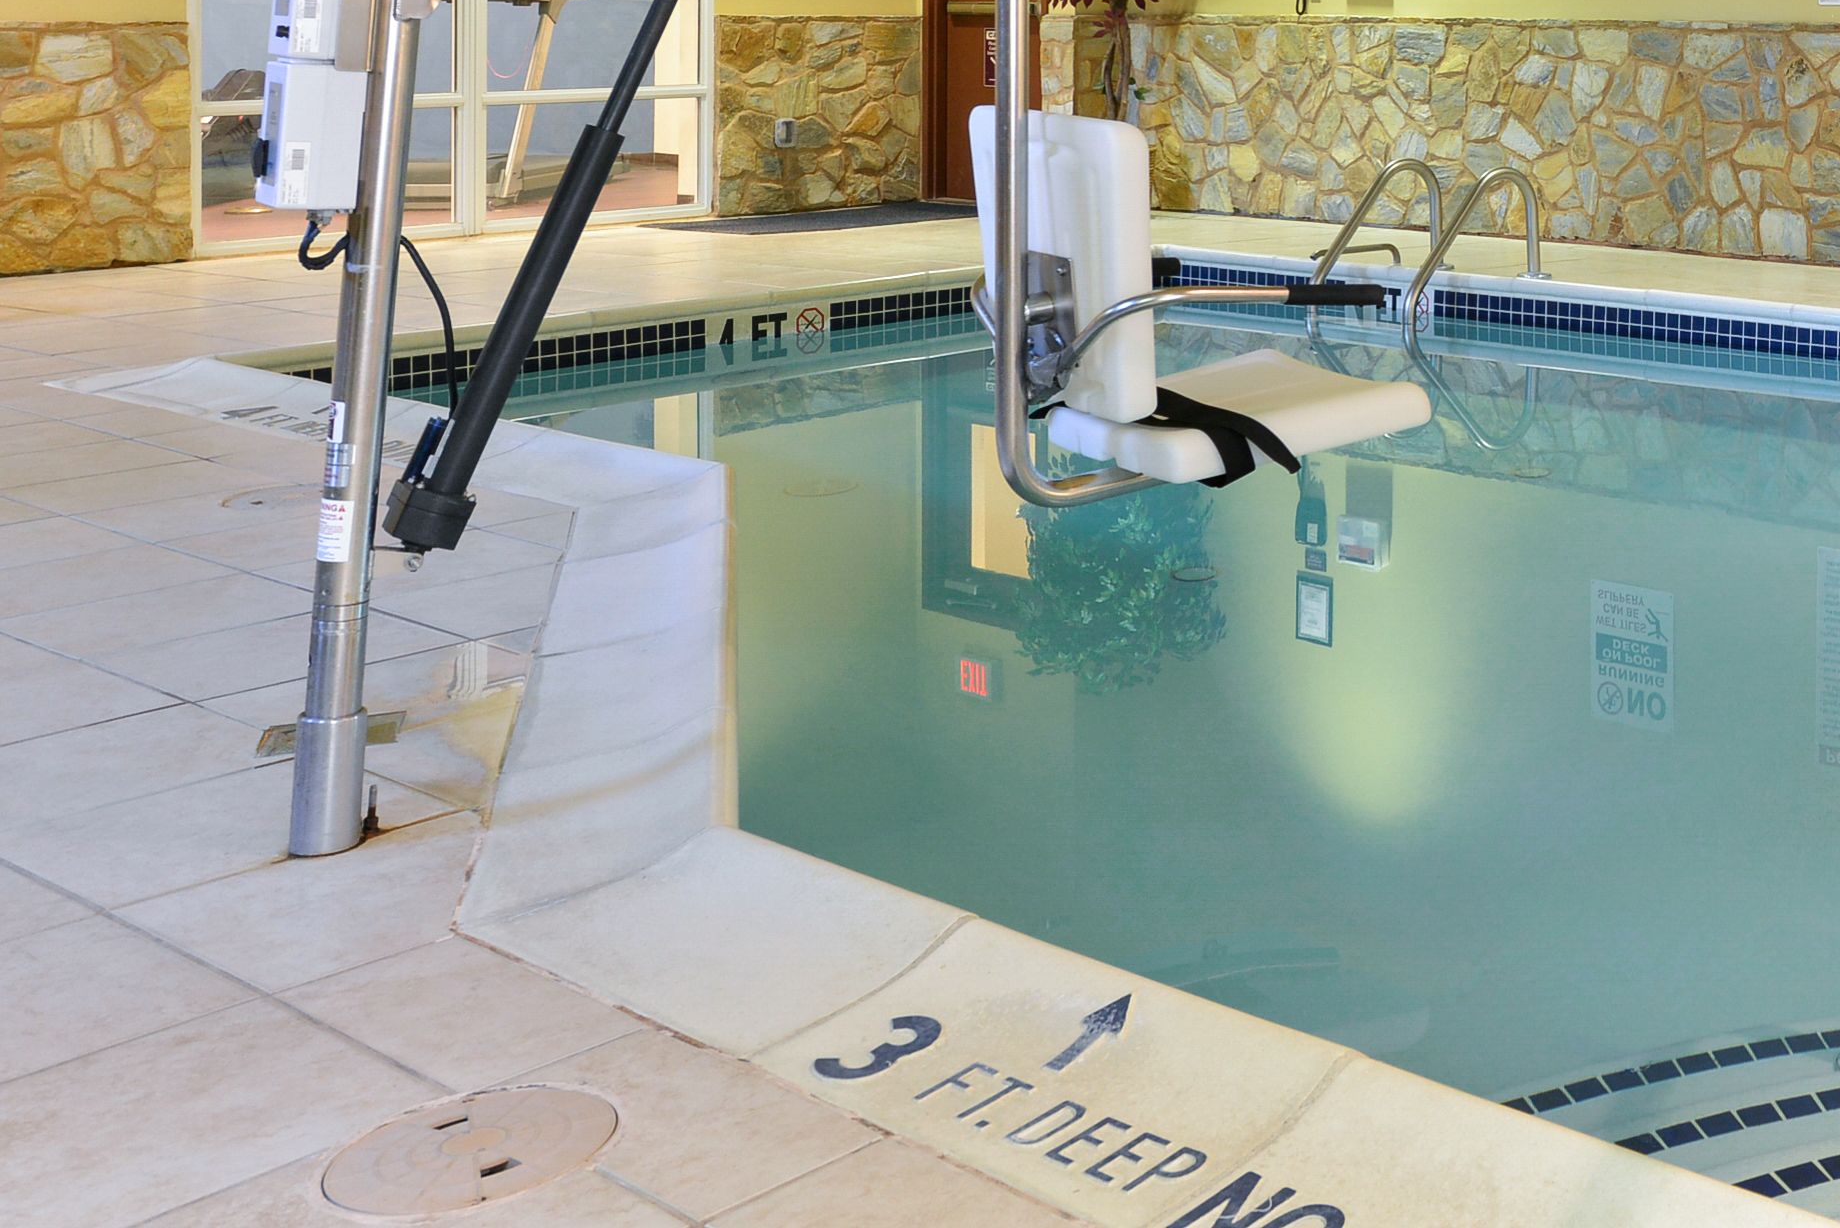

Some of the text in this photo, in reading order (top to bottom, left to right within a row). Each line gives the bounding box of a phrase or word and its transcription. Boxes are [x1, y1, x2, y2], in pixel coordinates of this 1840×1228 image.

[814, 1015, 942, 1079] 3
[913, 1062, 1034, 1128] FT.
[1005, 1100, 1208, 1193] DEEP
